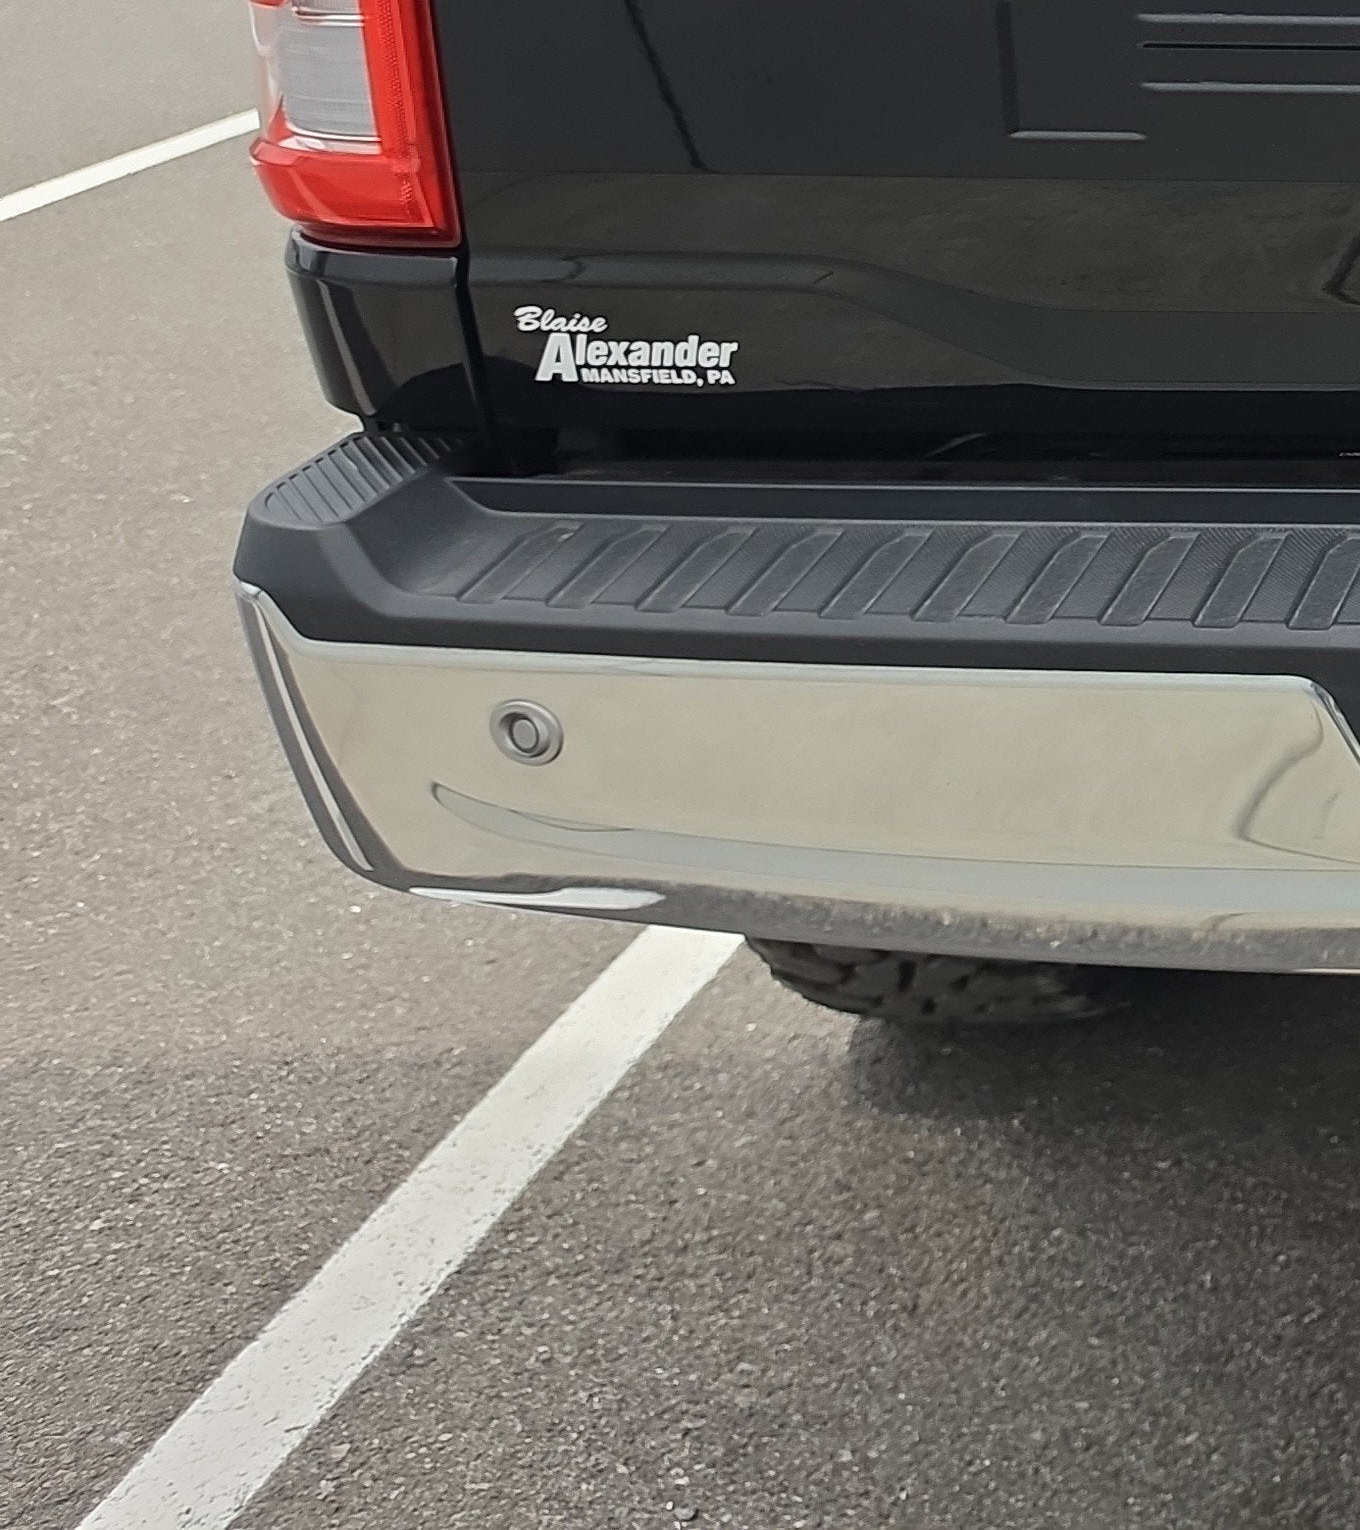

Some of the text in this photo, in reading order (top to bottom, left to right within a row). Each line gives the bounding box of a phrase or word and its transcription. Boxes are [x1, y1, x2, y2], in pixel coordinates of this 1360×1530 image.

[514, 305, 608, 333] Blaise
[535, 332, 739, 383] Alexander
[581, 368, 736, 388] MANSFIELD, PA
